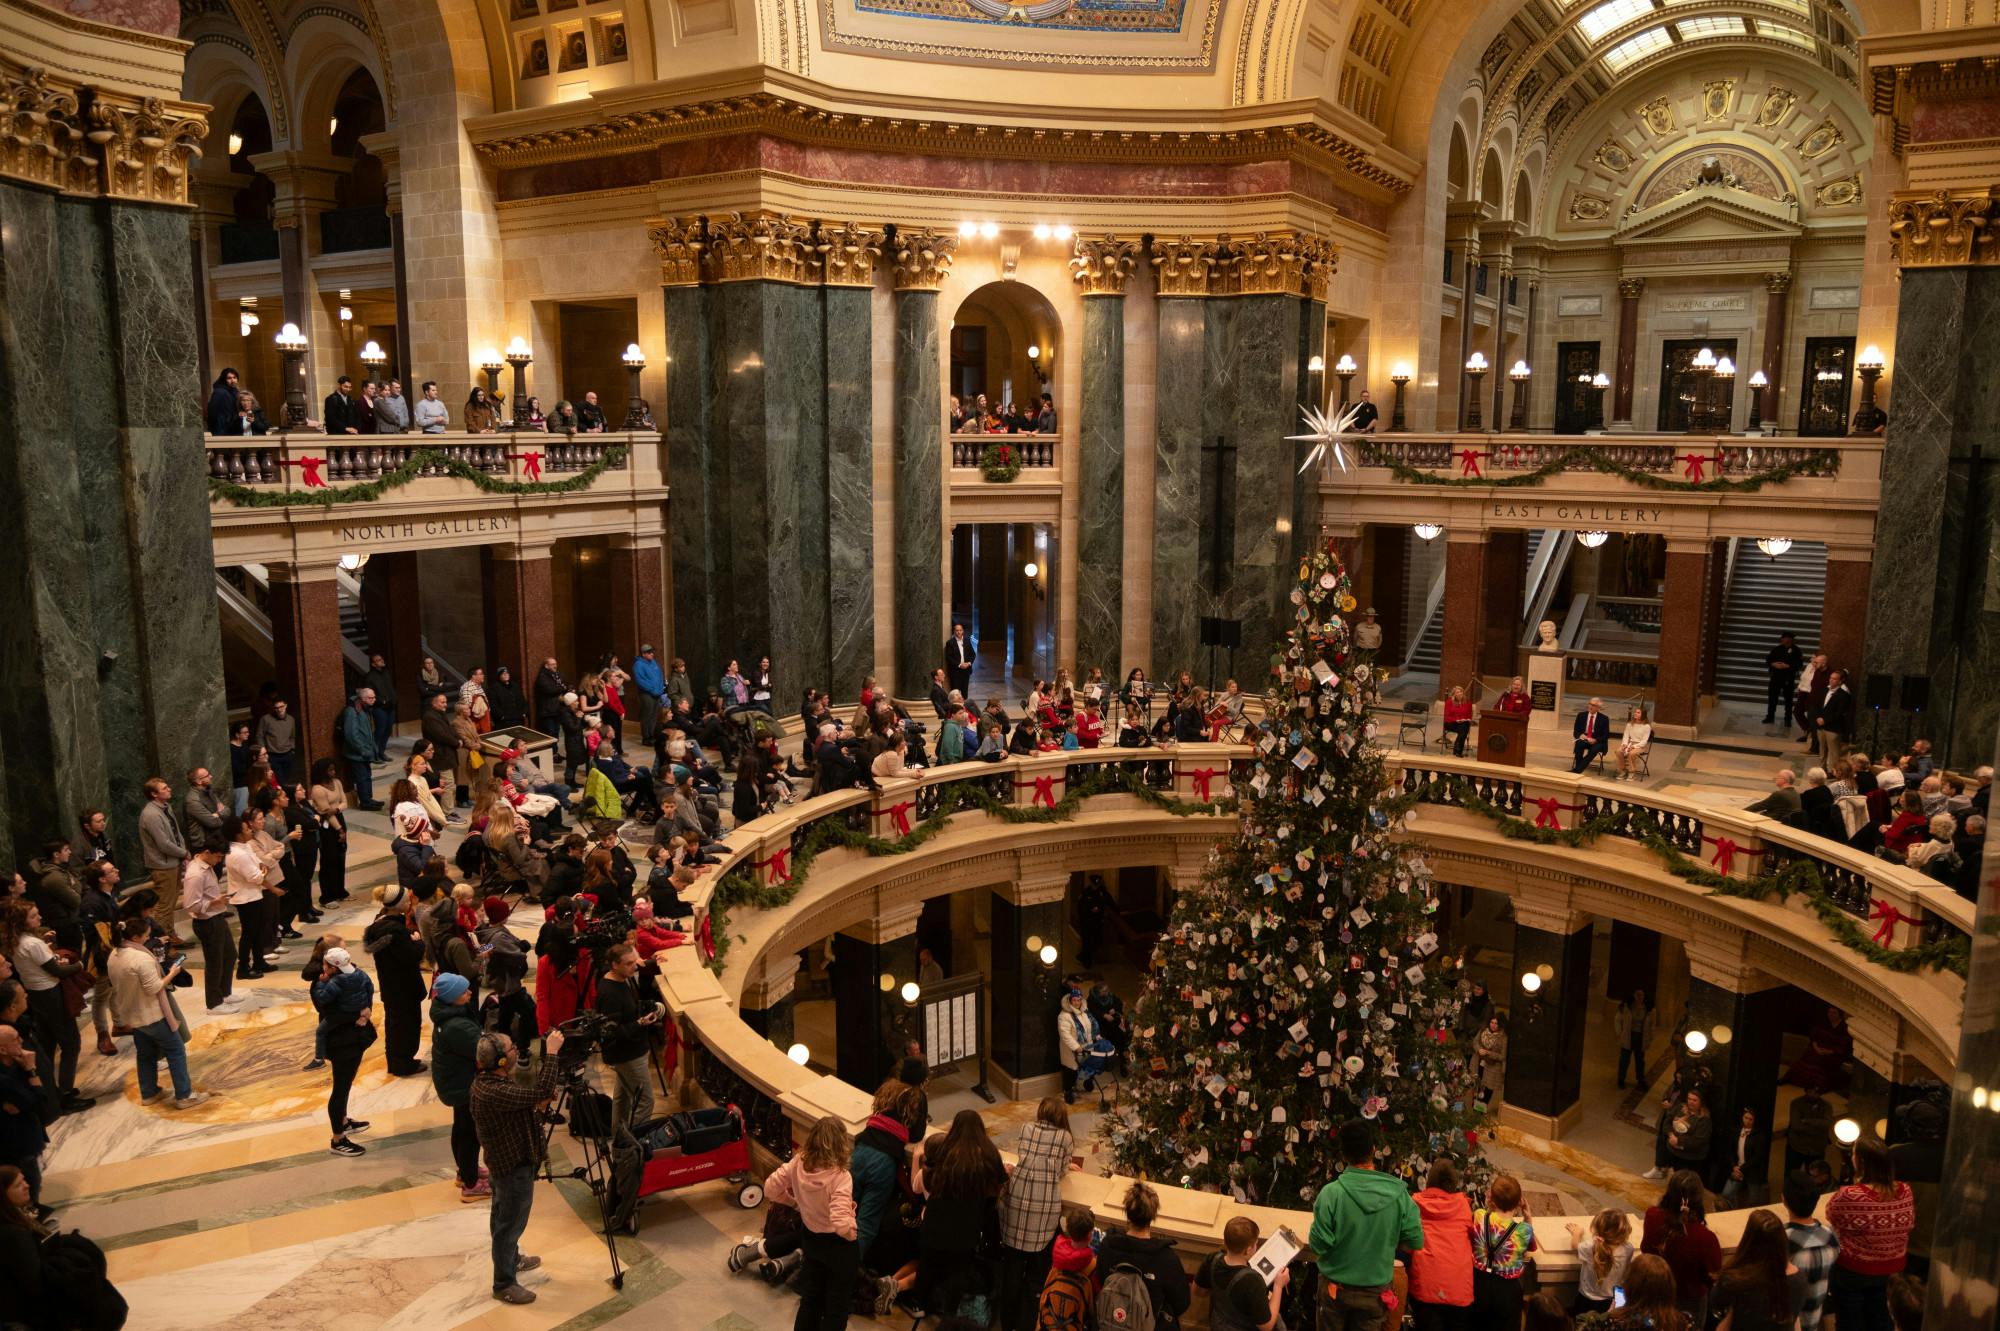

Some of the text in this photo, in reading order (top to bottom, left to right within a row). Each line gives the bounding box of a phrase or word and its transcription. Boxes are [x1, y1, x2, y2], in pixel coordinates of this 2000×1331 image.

[1494, 504, 1662, 521] EAST GALLERY
[343, 515, 511, 541] NORTH GALLERY
